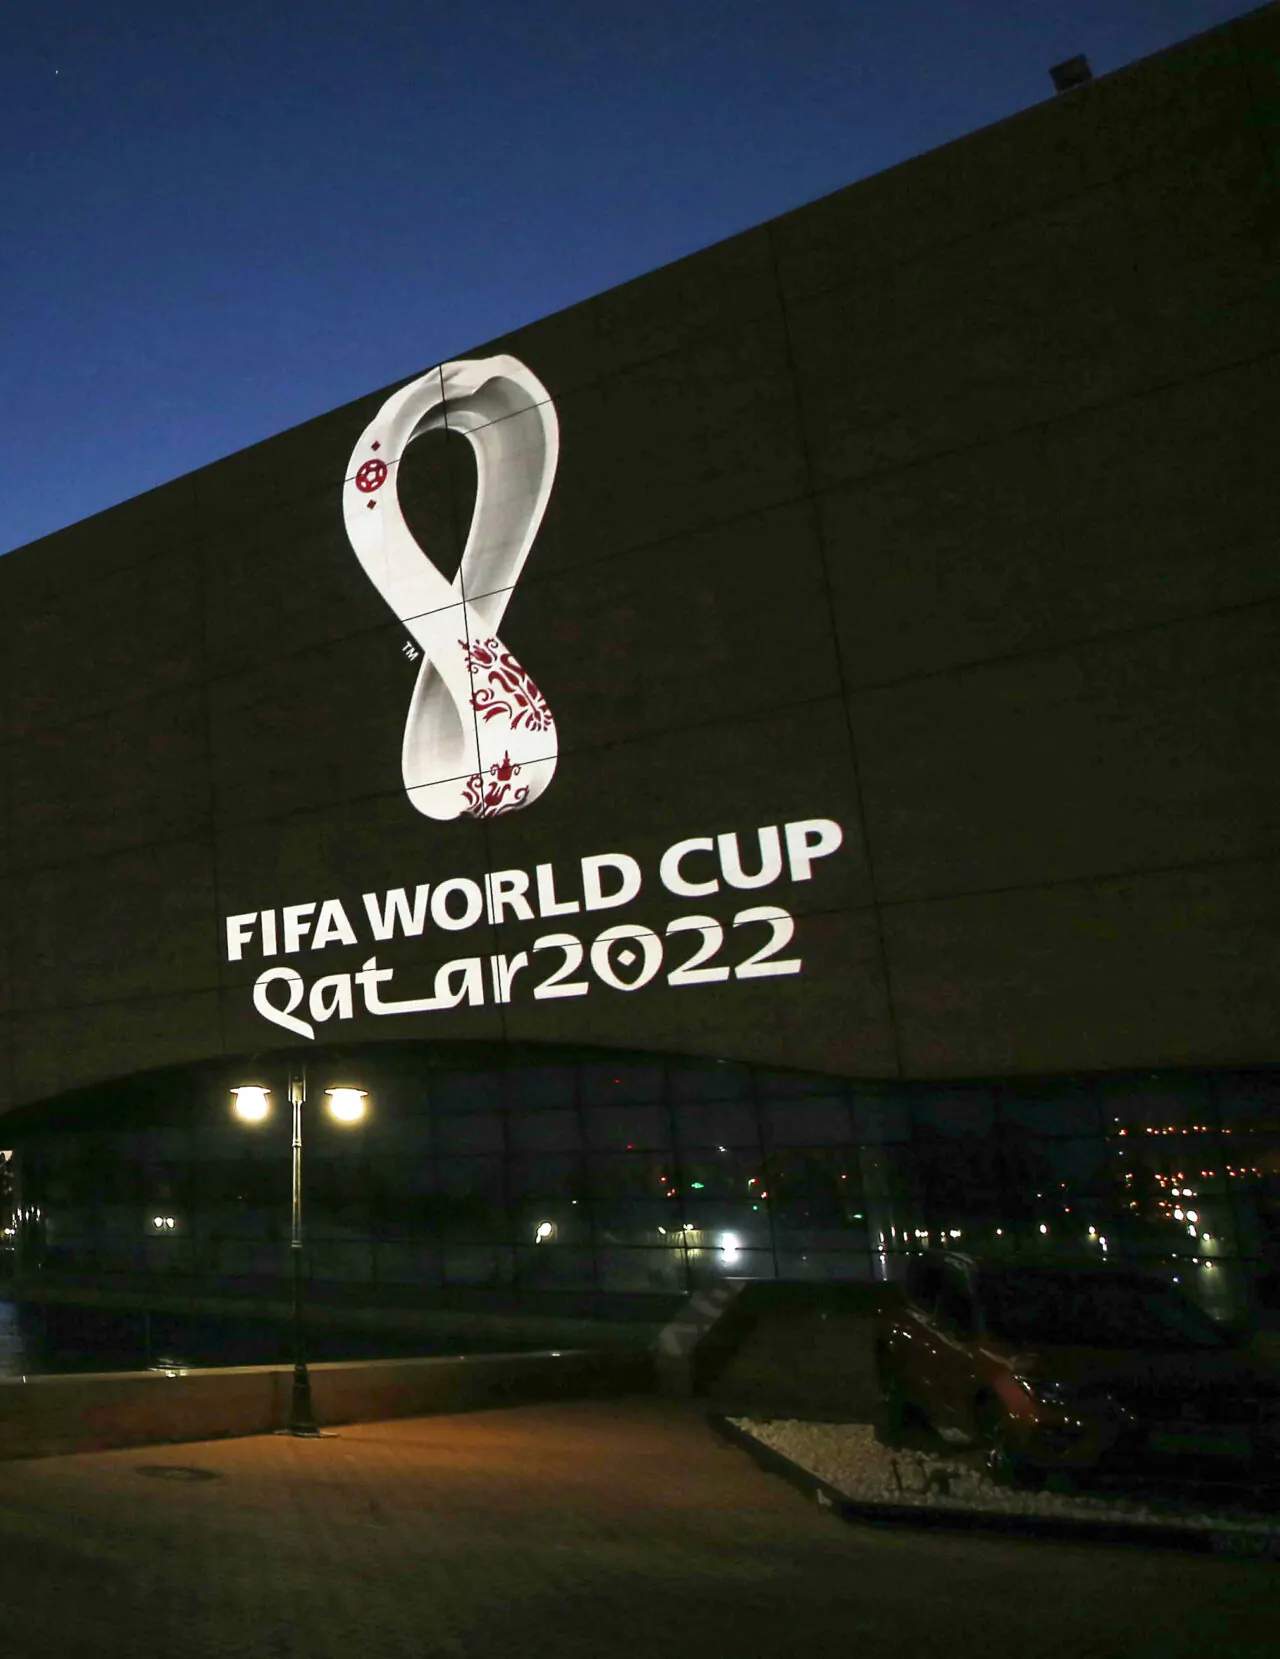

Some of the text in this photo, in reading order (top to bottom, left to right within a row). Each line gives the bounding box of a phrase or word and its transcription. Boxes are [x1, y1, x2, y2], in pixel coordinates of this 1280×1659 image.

[226, 818, 844, 962] FIFA WORLD CUP
